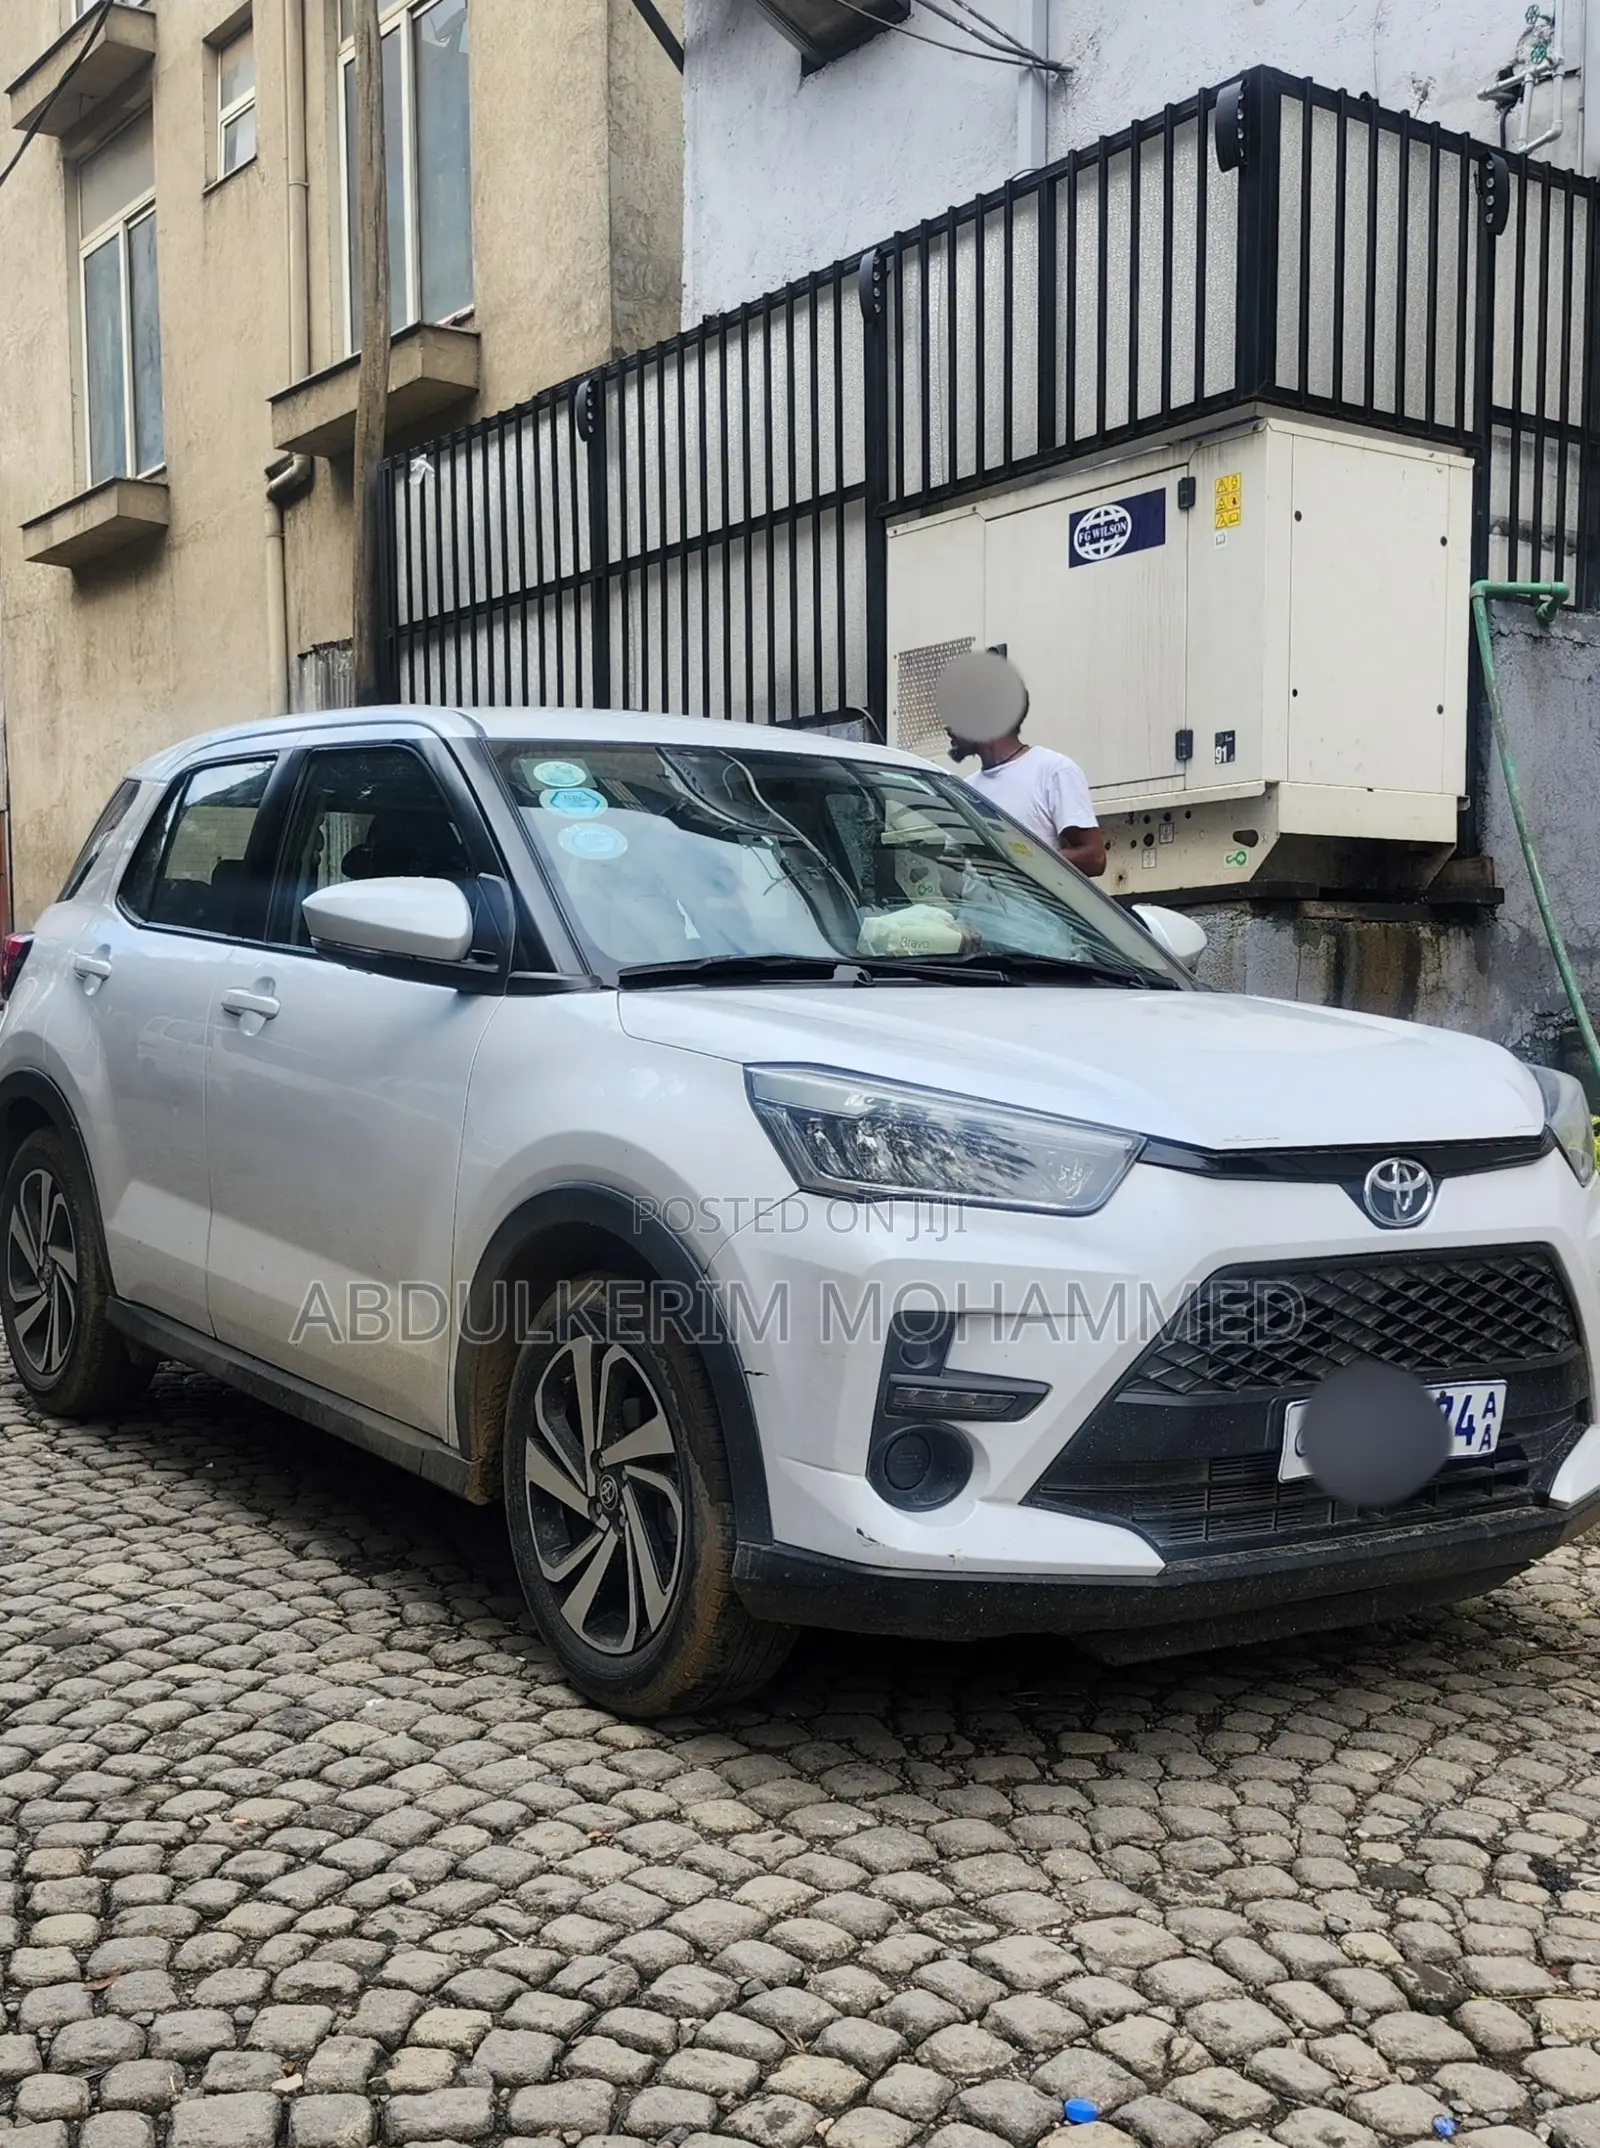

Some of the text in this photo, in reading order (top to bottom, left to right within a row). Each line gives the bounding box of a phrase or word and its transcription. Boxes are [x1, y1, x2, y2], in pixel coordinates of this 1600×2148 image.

[1079, 520, 1127, 543] FG WILSON
[1215, 745, 1227, 763] 91
